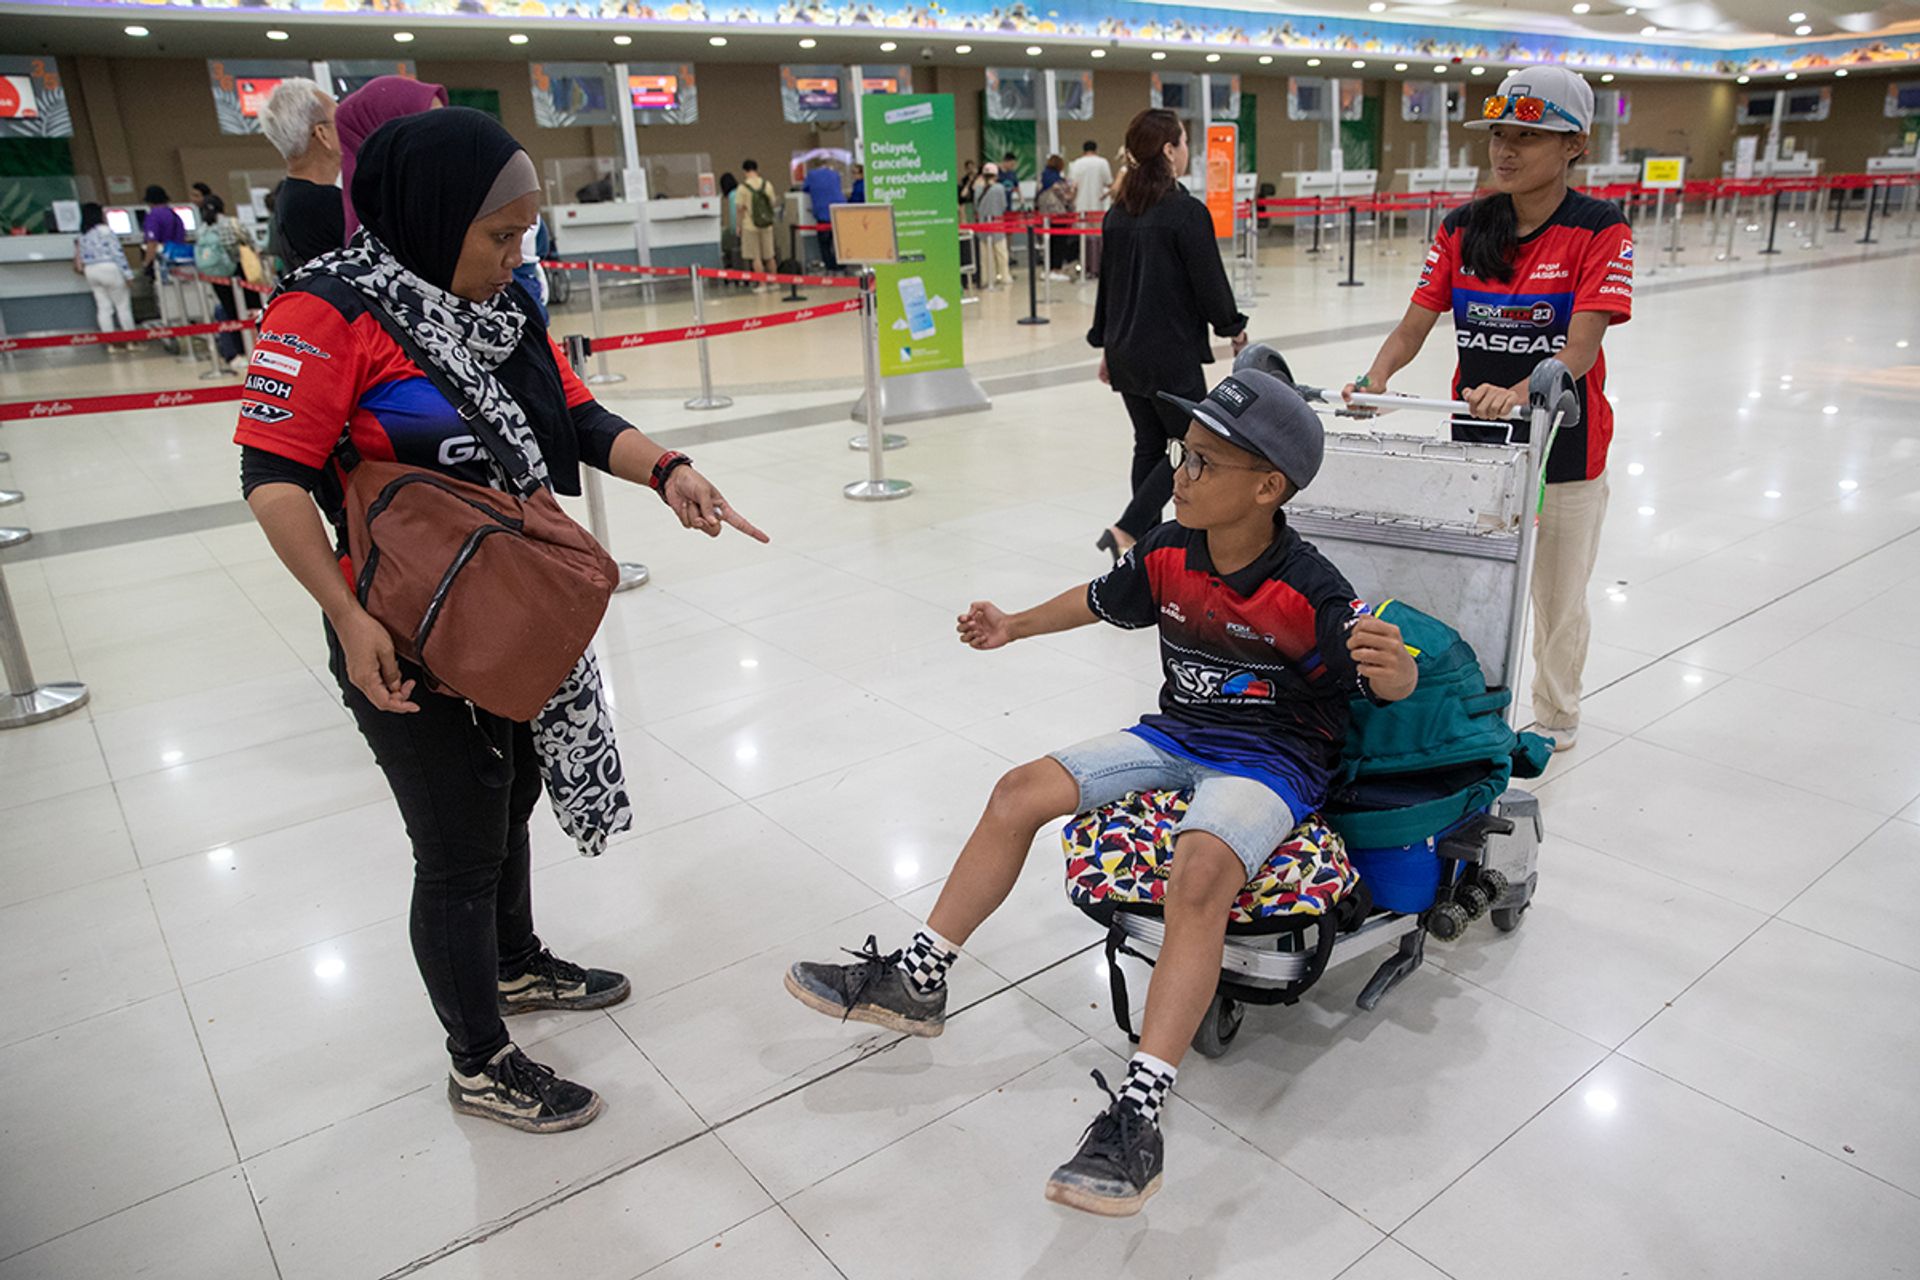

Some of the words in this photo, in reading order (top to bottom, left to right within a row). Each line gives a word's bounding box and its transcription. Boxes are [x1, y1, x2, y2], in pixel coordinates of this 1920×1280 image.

[871, 141, 917, 157] Delayed,
[872, 156, 921, 169] cancelled
[873, 176, 884, 184] or
[886, 170, 948, 184] rescheduled
[873, 187, 907, 203] flight?
[1456, 330, 1567, 354] GASGAS
